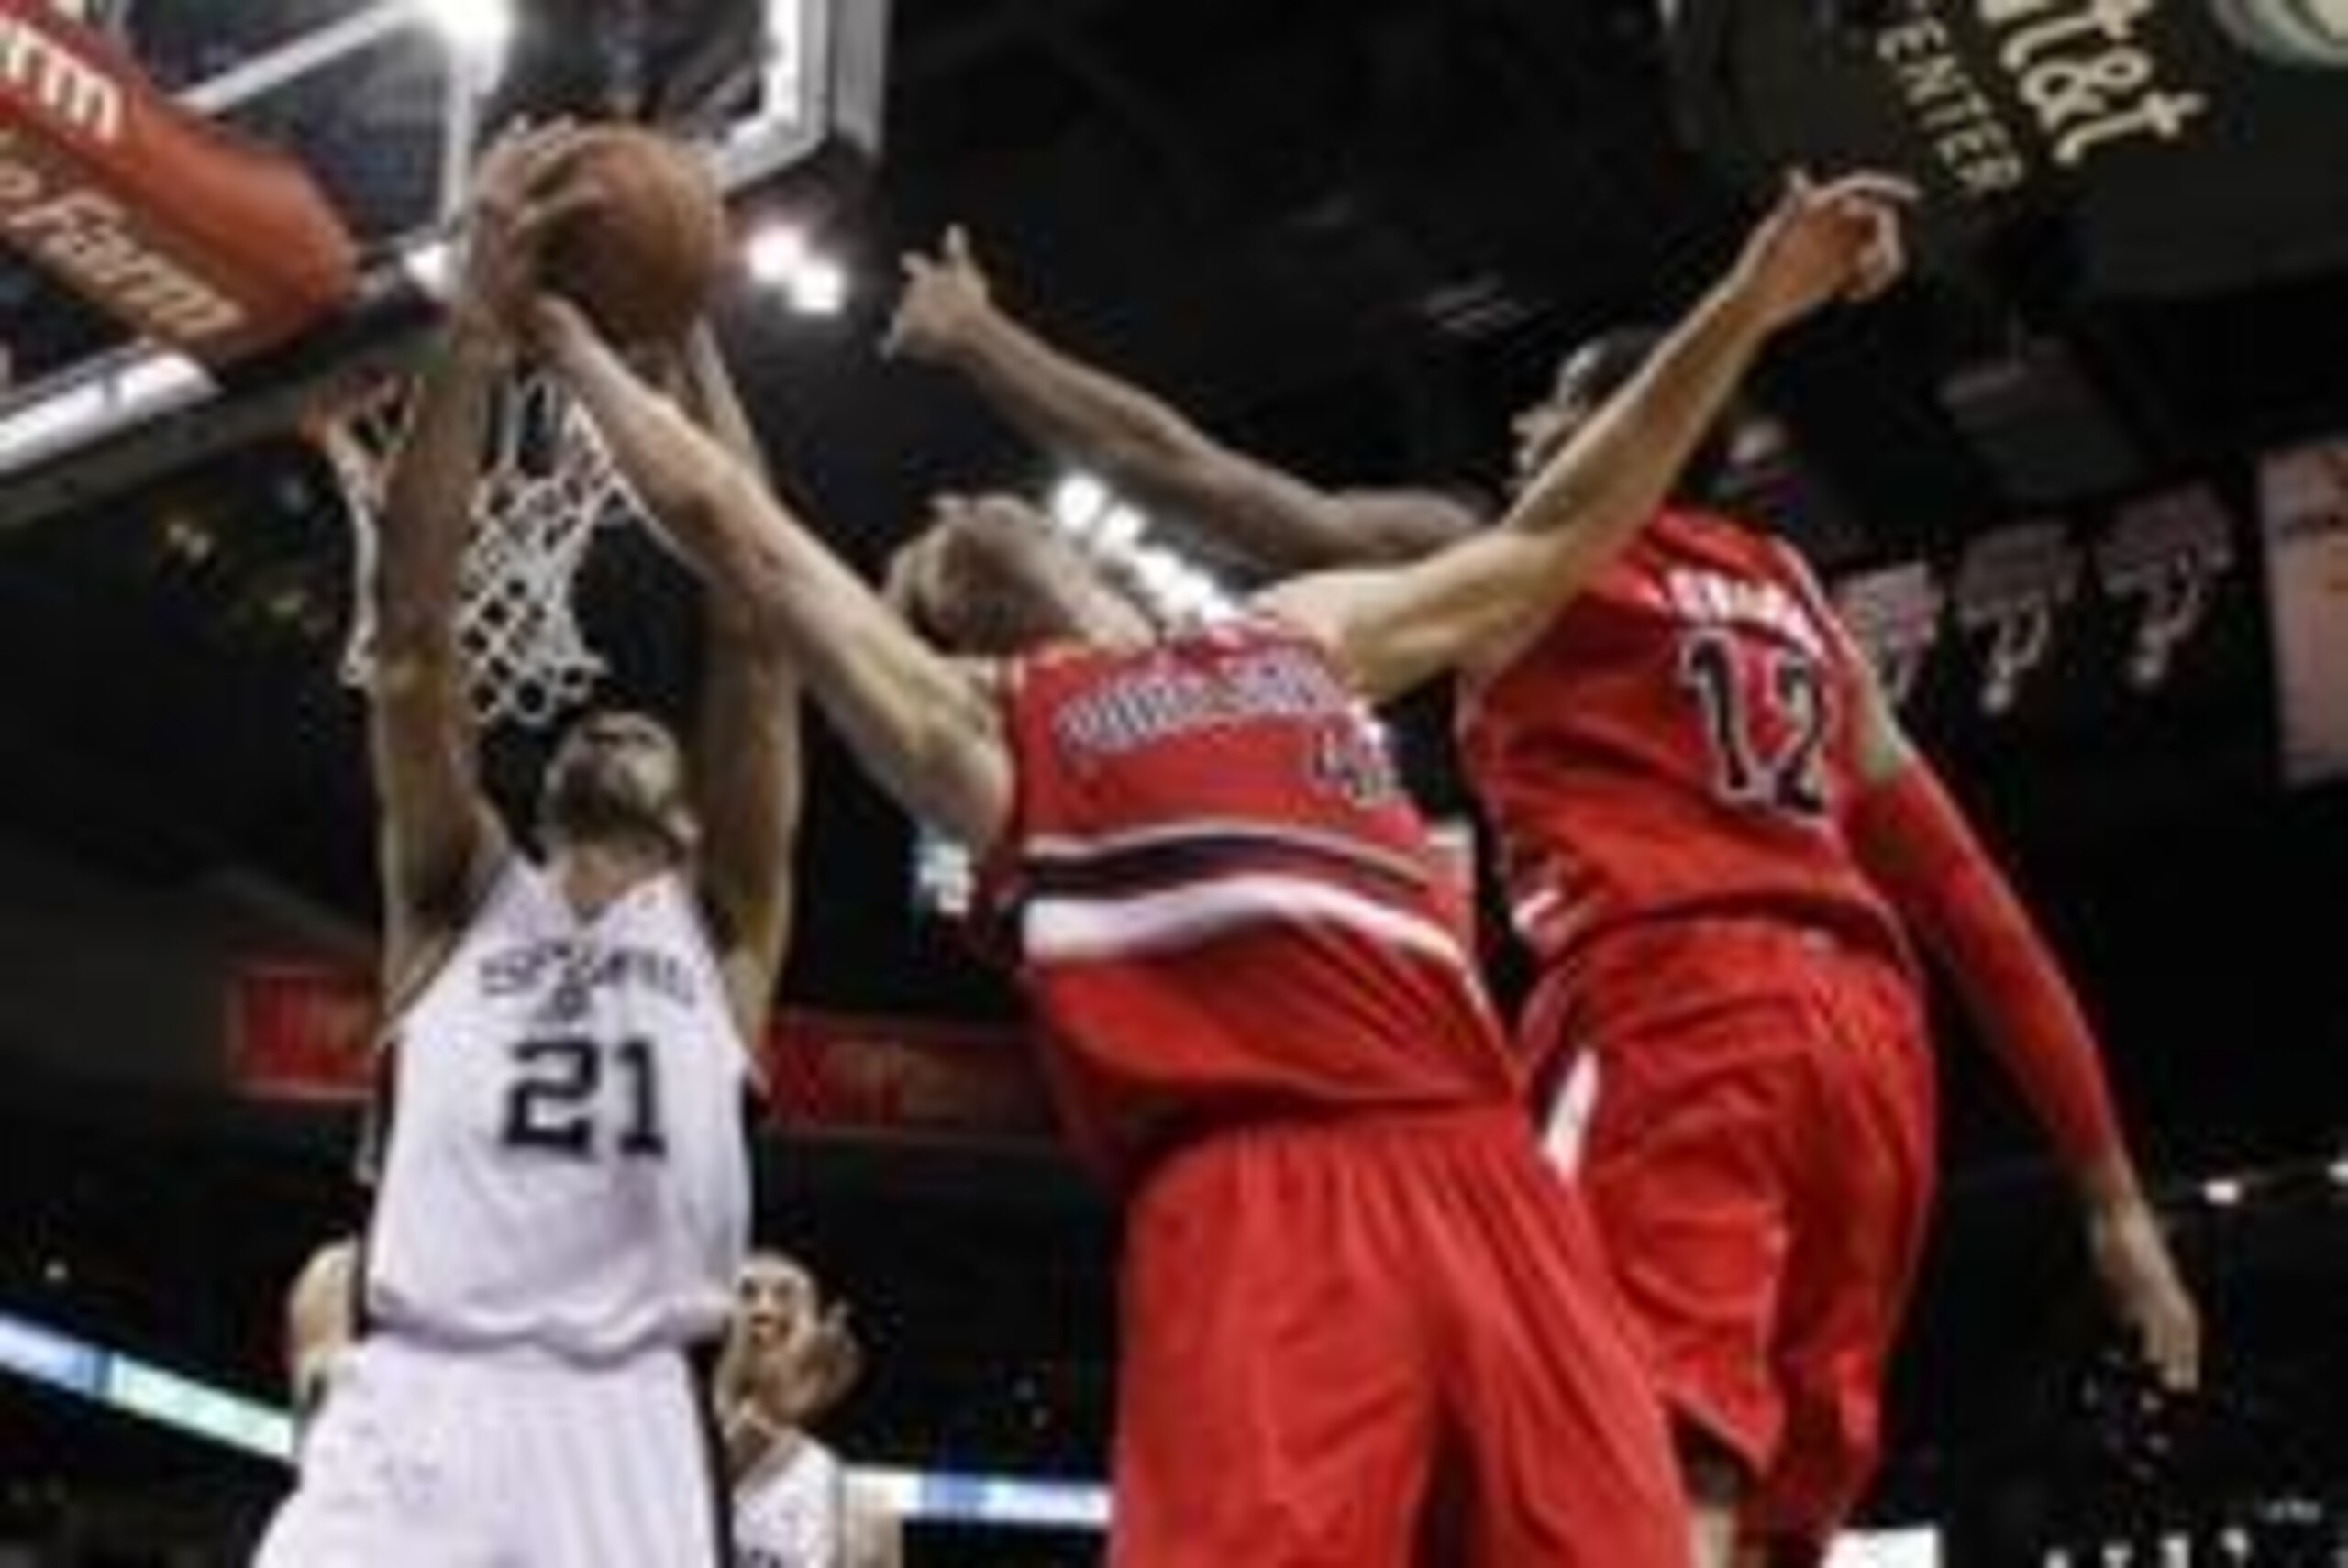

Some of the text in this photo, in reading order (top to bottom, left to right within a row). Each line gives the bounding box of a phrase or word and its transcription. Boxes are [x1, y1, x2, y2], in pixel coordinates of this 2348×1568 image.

[1877, 0, 2025, 193] ENTER
[1678, 629, 1836, 829] 12
[503, 1036, 668, 1159] 21
